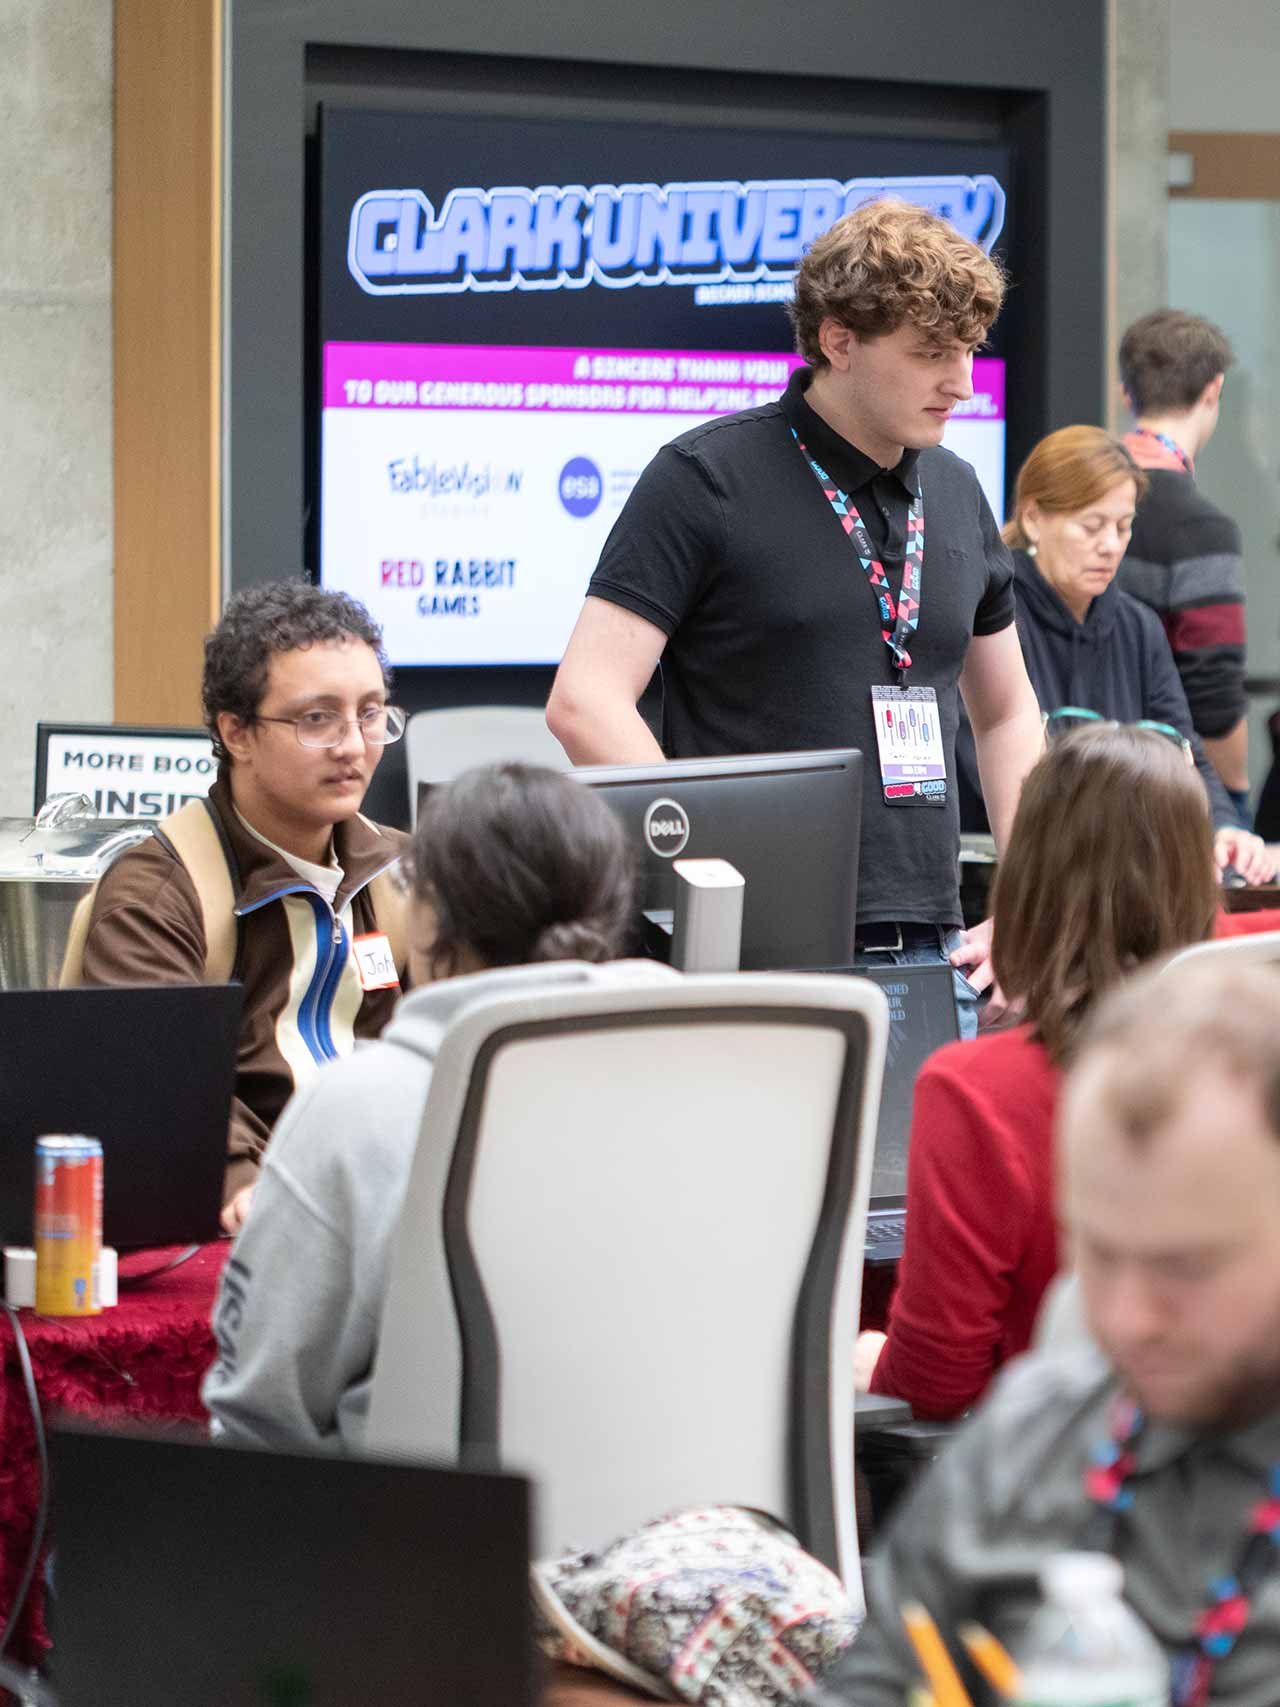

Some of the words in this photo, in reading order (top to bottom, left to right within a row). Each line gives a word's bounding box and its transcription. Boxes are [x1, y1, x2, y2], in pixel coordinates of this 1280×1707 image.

[350, 188, 590, 293] CLARK
[590, 176, 1004, 286] UNIVERY
[344, 379, 372, 404] TO
[382, 559, 424, 587] RED
[435, 559, 517, 586] RABBIT
[63, 750, 144, 772] MORE
[154, 755, 212, 774] BOO
[651, 819, 685, 837] DELL
